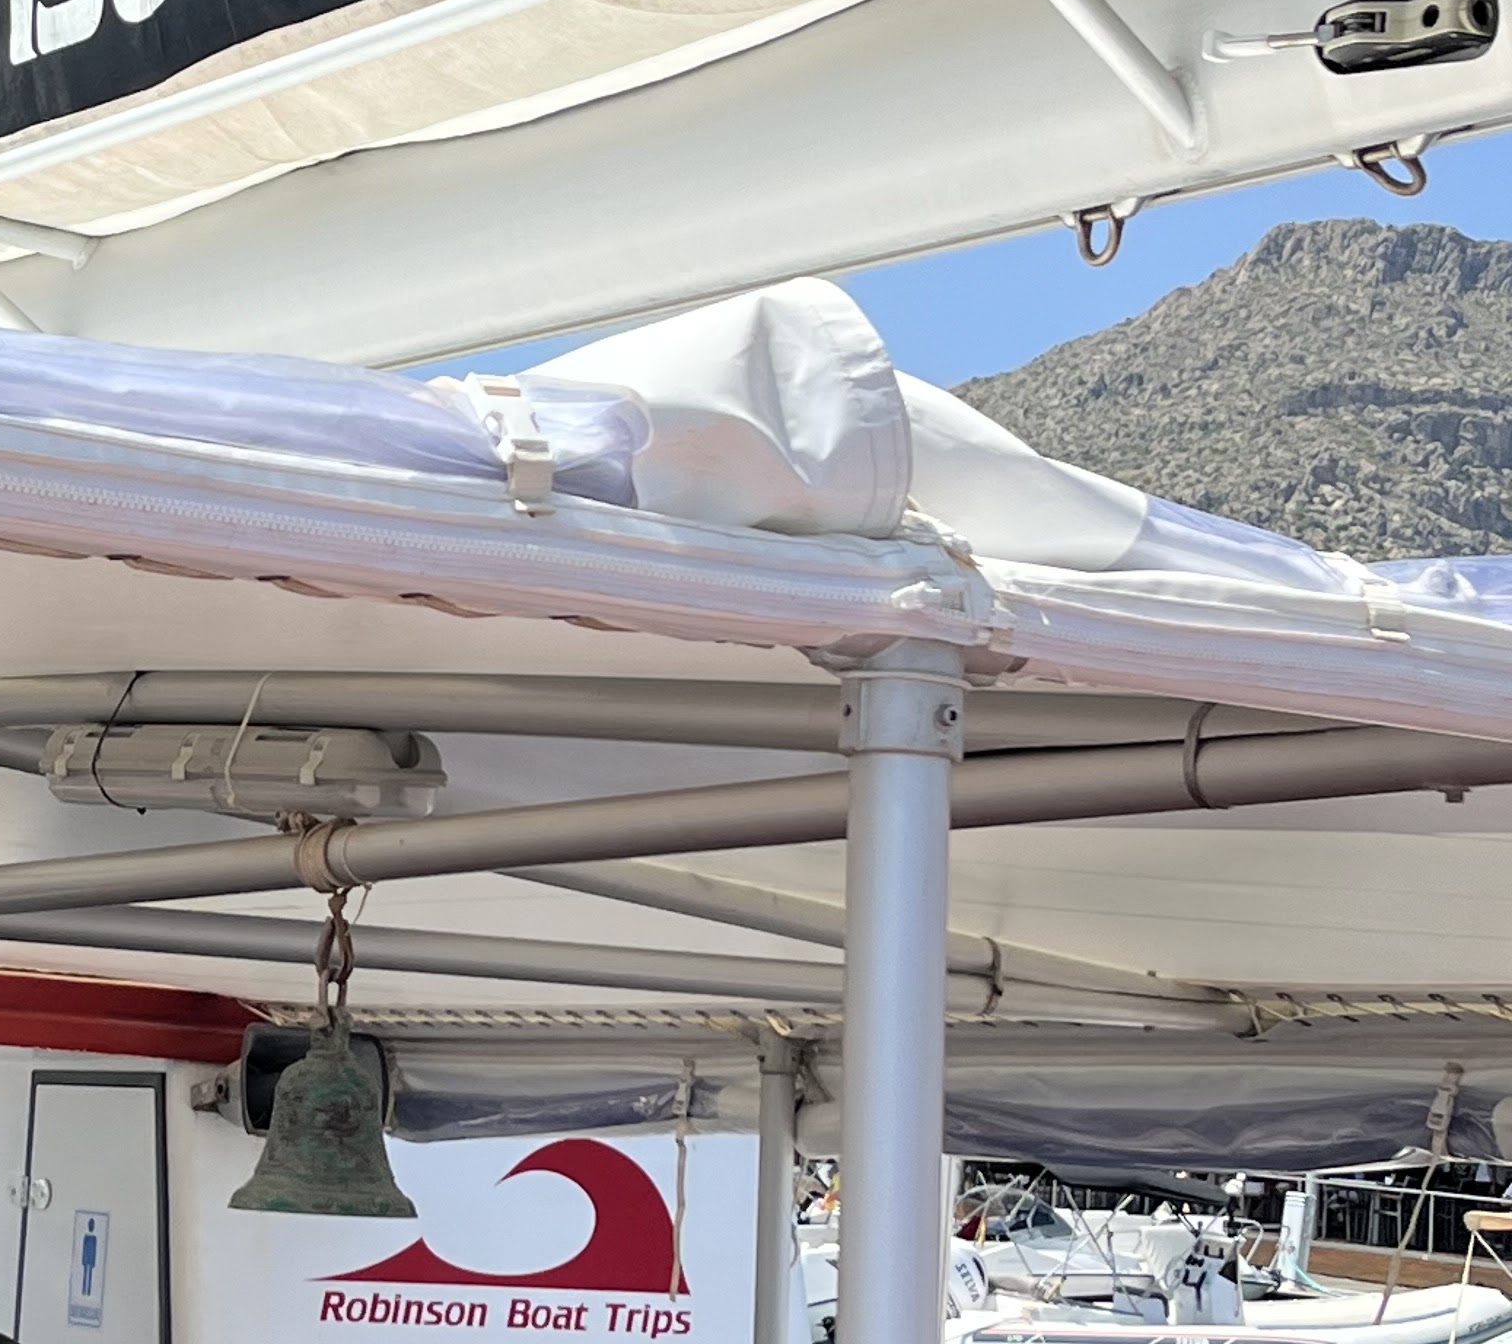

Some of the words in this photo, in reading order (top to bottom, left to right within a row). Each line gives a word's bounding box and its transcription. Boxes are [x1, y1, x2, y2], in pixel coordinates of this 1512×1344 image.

[320, 1290, 488, 1327] Robinson
[507, 1298, 588, 1331] Boat
[605, 1302, 692, 1339] Trips
